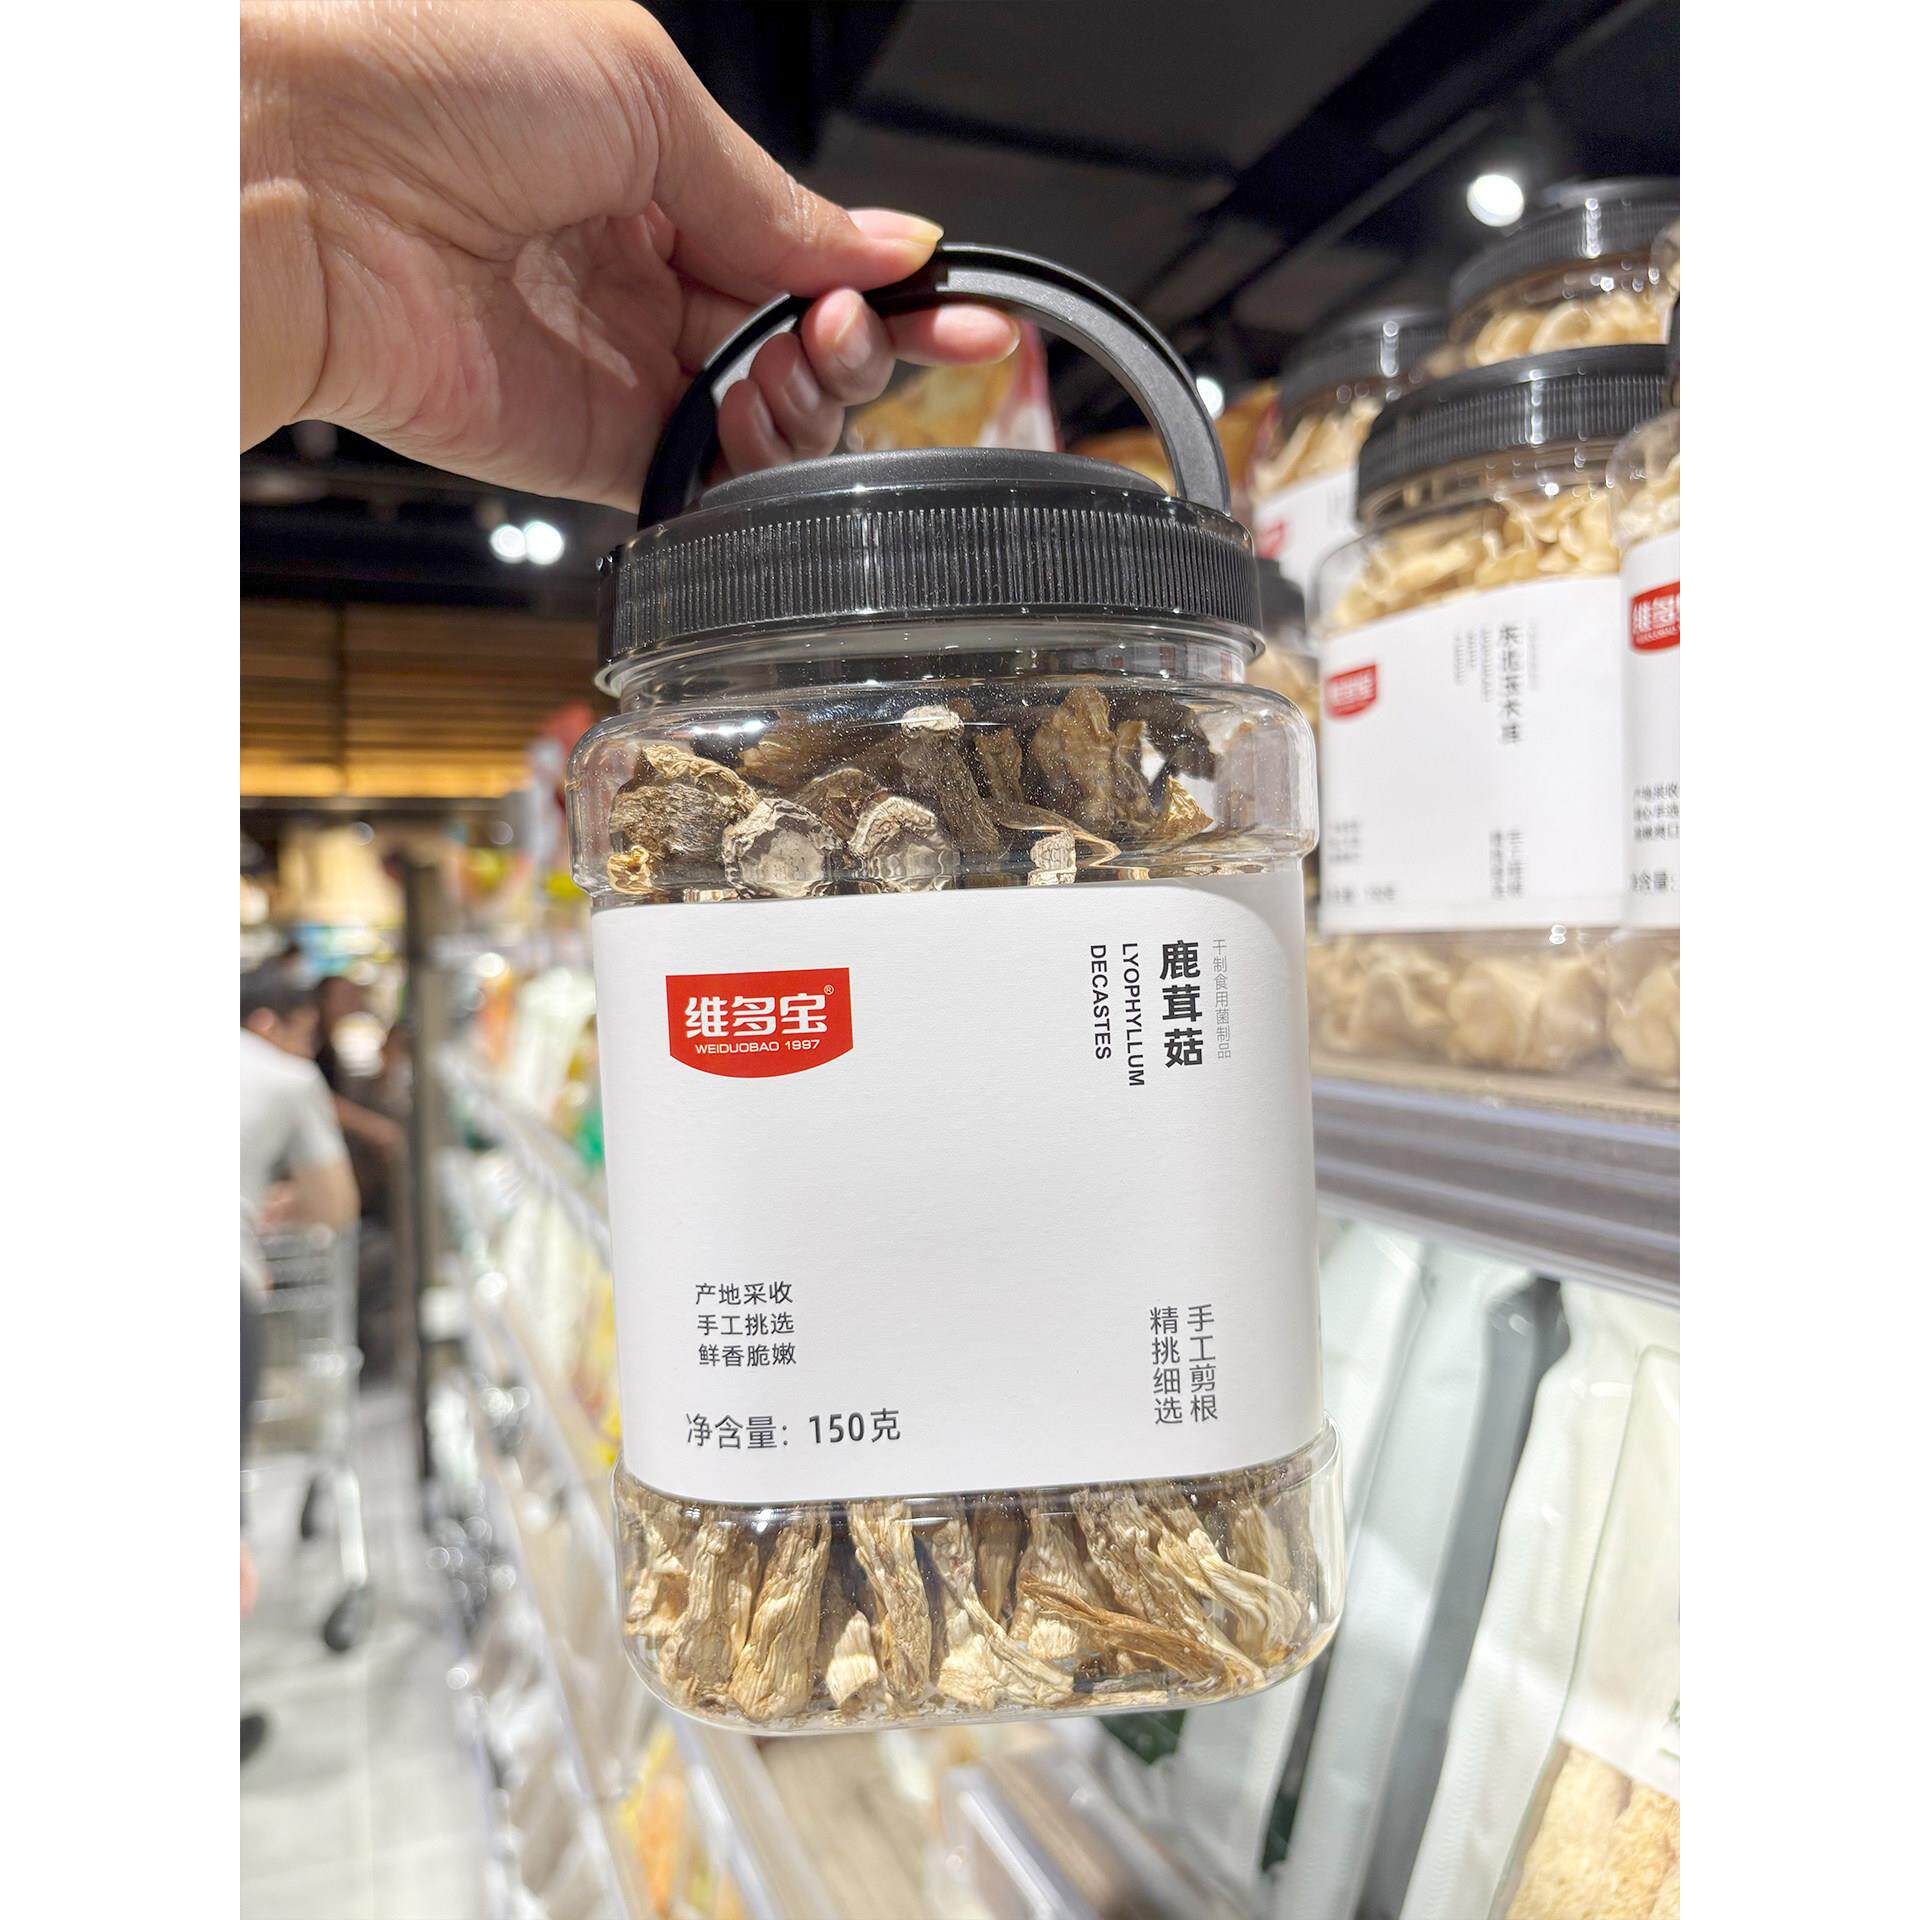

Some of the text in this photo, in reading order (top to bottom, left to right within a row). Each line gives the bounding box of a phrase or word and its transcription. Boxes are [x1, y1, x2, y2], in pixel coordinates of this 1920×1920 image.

[684, 993, 828, 1039] 维多宝
[696, 1041, 780, 1055] WEIDUOBAO
[1090, 945, 1112, 1060] DECASTES
[1122, 943, 1145, 1086] LYOPHYLLUM
[1160, 940, 1204, 1068] 鹿茸菇
[1212, 939, 1232, 1059] 干制食用菌制品
[695, 1280, 794, 1305] 产地采收
[697, 1312, 795, 1336] 手工挑选
[698, 1342, 797, 1367] 鲜香脆嫩
[1150, 1306, 1183, 1424] 精挑细选
[1187, 1304, 1218, 1423] 手工剪根
